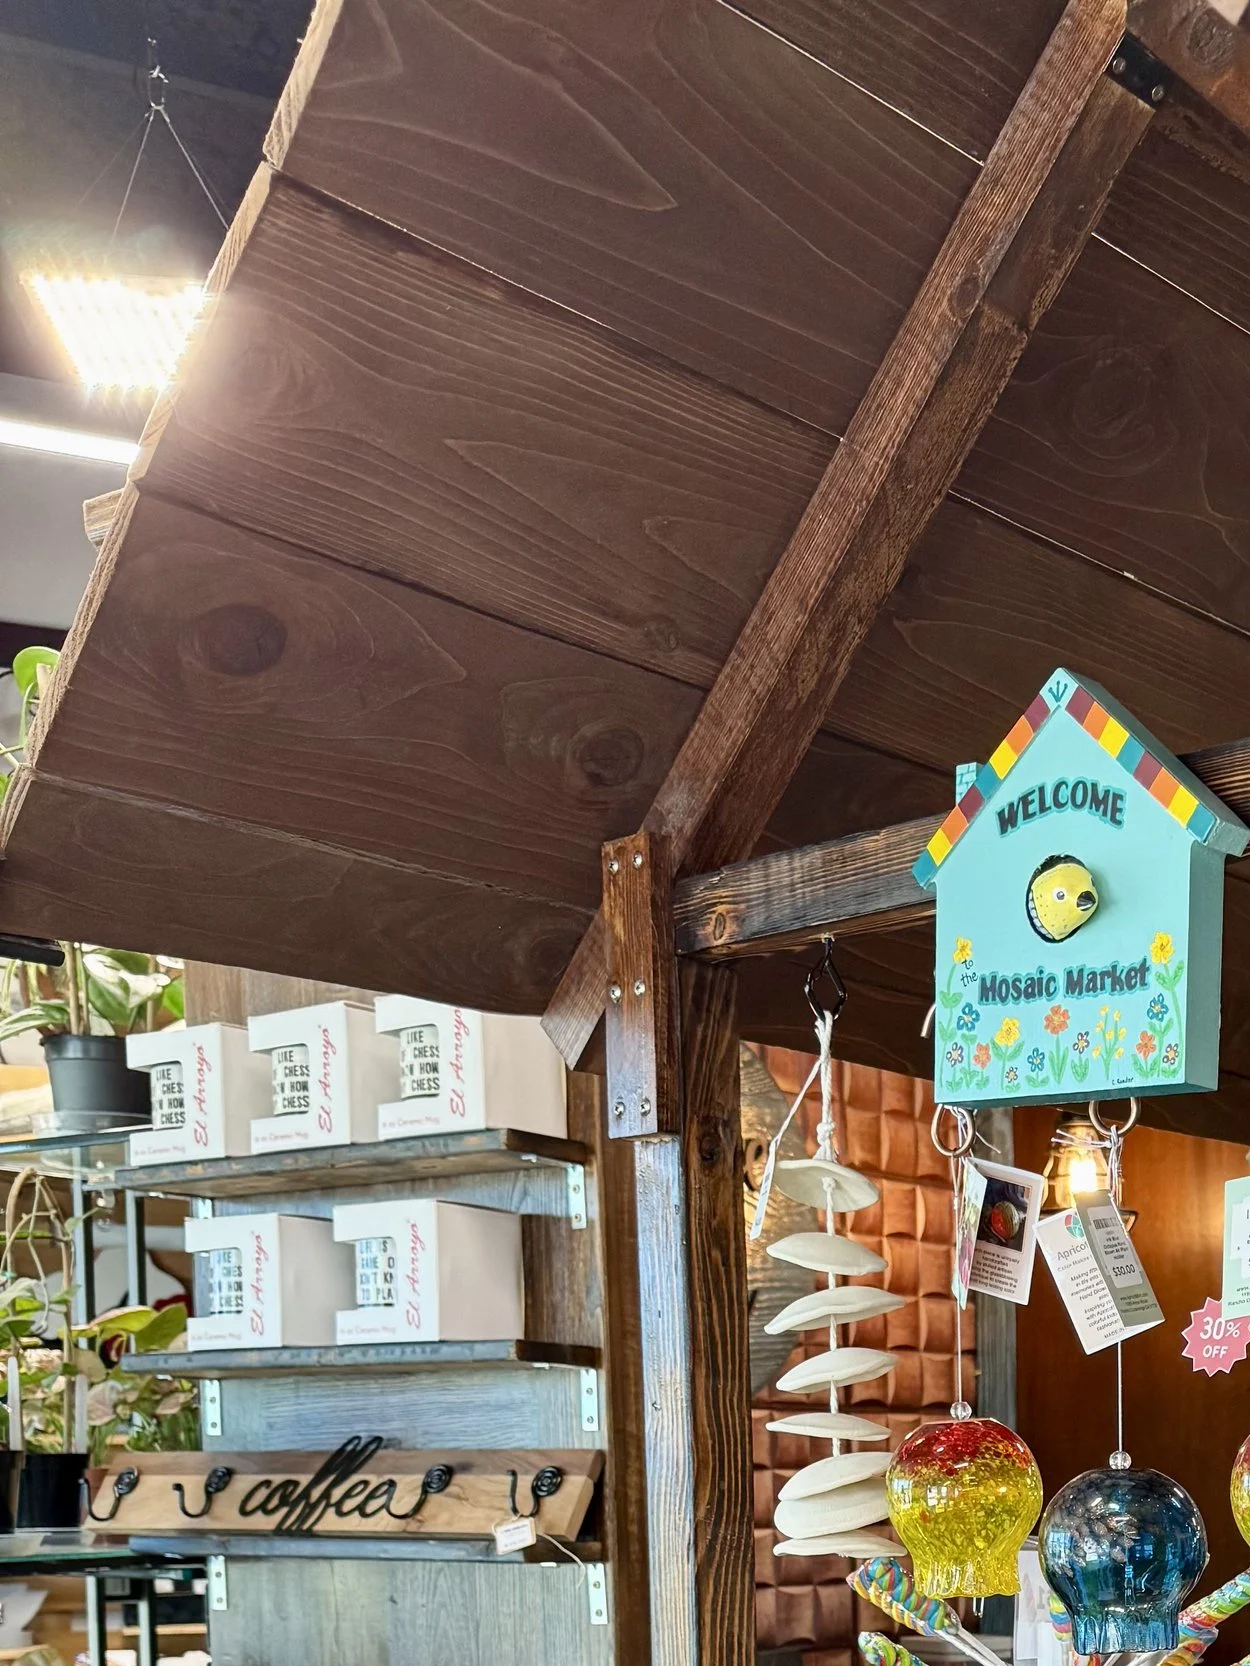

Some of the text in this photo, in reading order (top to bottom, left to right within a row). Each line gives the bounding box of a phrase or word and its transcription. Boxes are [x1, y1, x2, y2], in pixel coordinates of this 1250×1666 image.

[998, 780, 1124, 834] WELCOME
[962, 960, 973, 970] to
[961, 958, 1150, 1002] the Mosaic Market
[407, 1030, 424, 1043] LIKE
[420, 1064, 439, 1074] HOW
[412, 1078, 440, 1092] CHESS
[1112, 1264, 1136, 1279] $30.00
[1200, 1317, 1241, 1340] 30%
[1203, 1345, 1228, 1358] OFF
[239, 1435, 397, 1536] coffee
